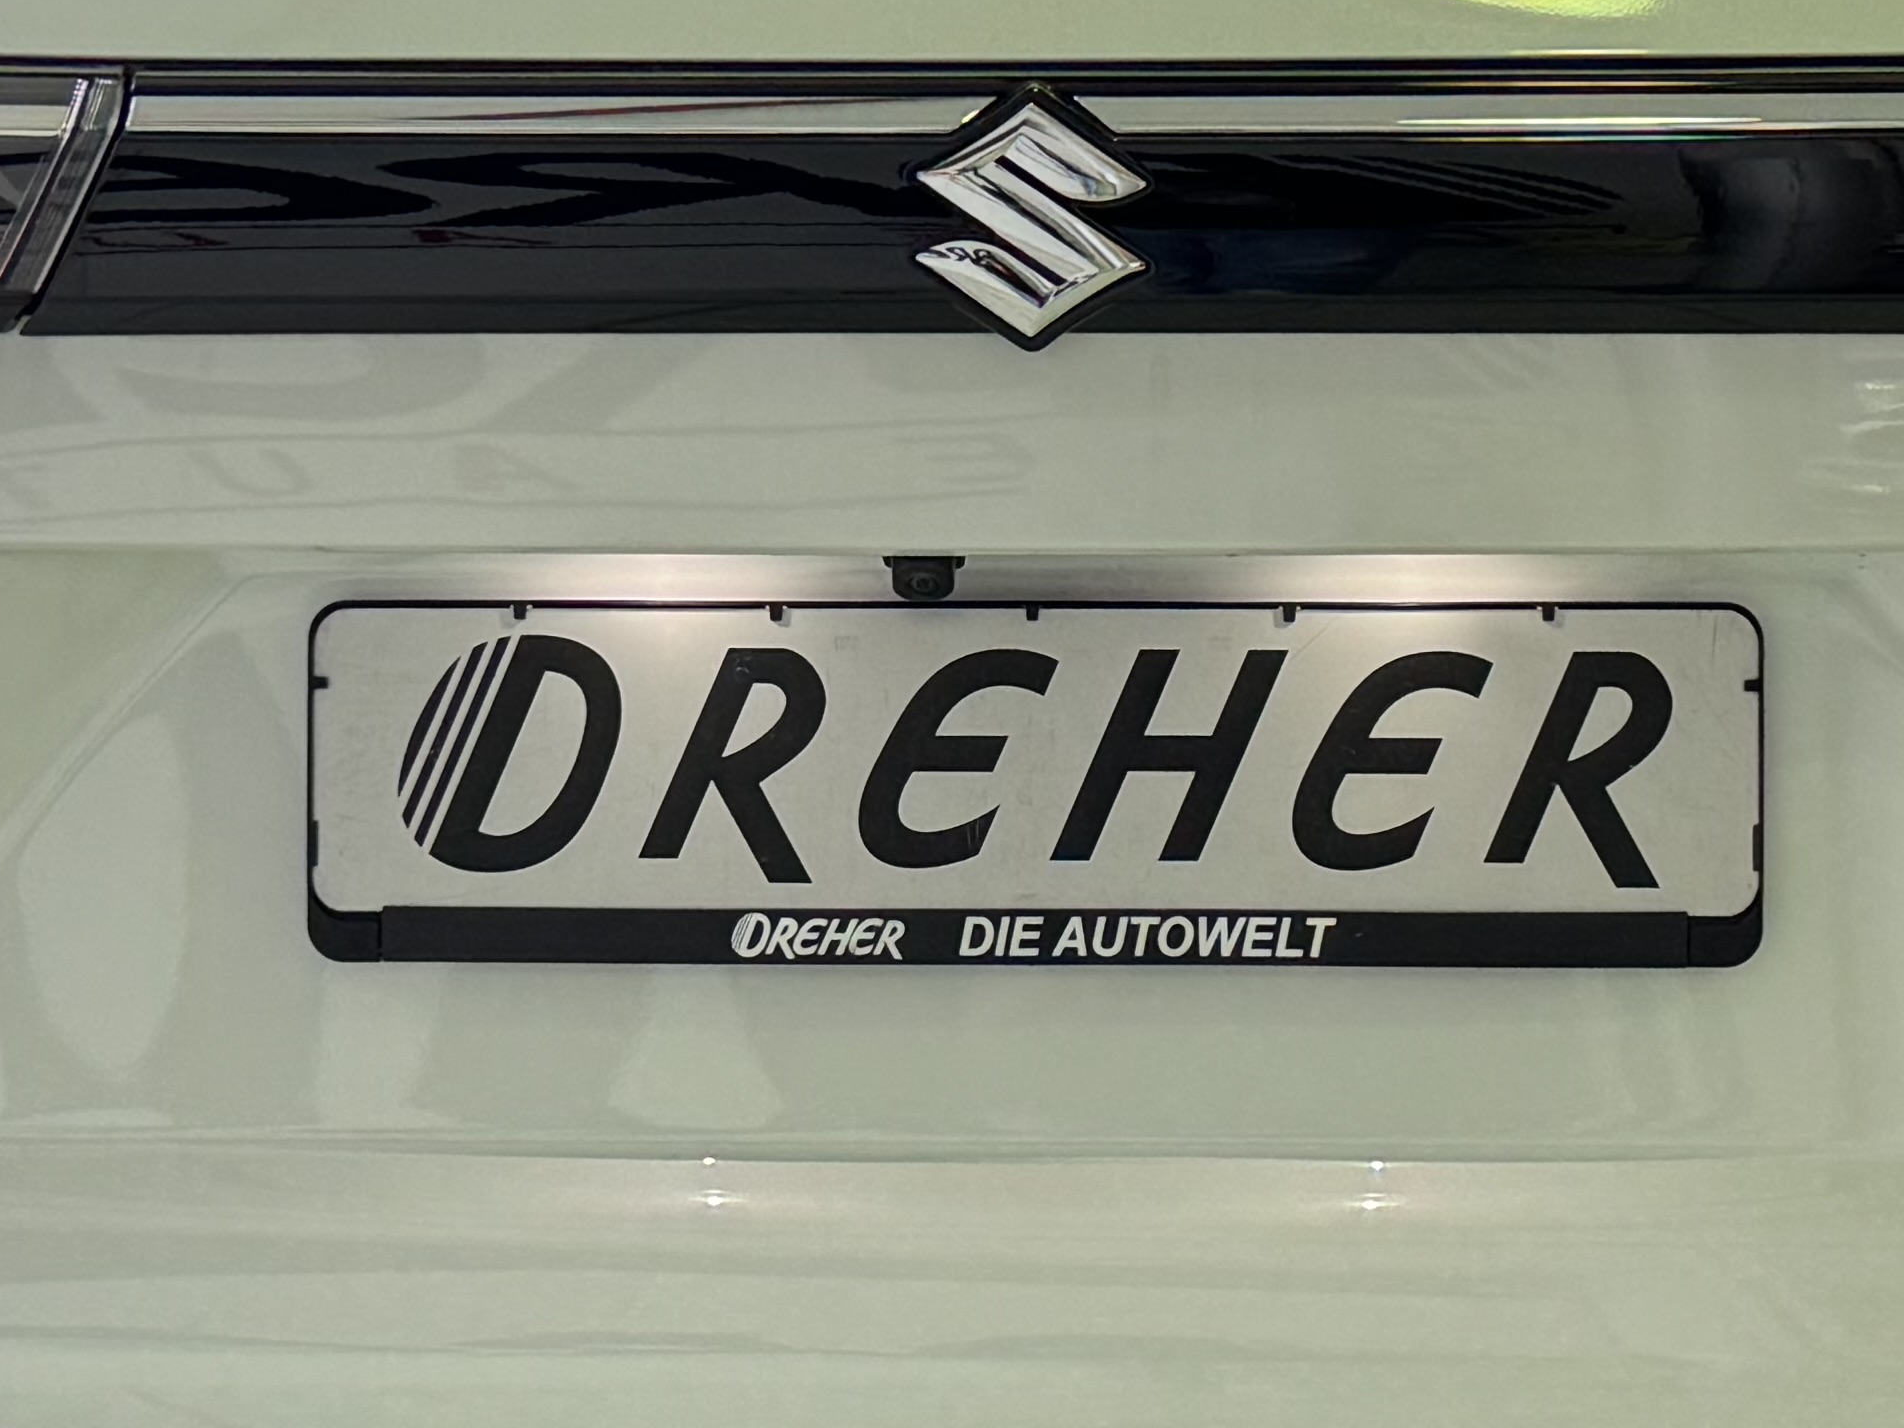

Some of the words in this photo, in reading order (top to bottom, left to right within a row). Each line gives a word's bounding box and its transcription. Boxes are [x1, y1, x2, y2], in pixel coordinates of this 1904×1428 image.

[398, 634, 1675, 889] DREHER
[730, 912, 906, 960] DREHER
[958, 916, 1045, 958] DIE
[1051, 916, 1338, 959] AUTOWELT
